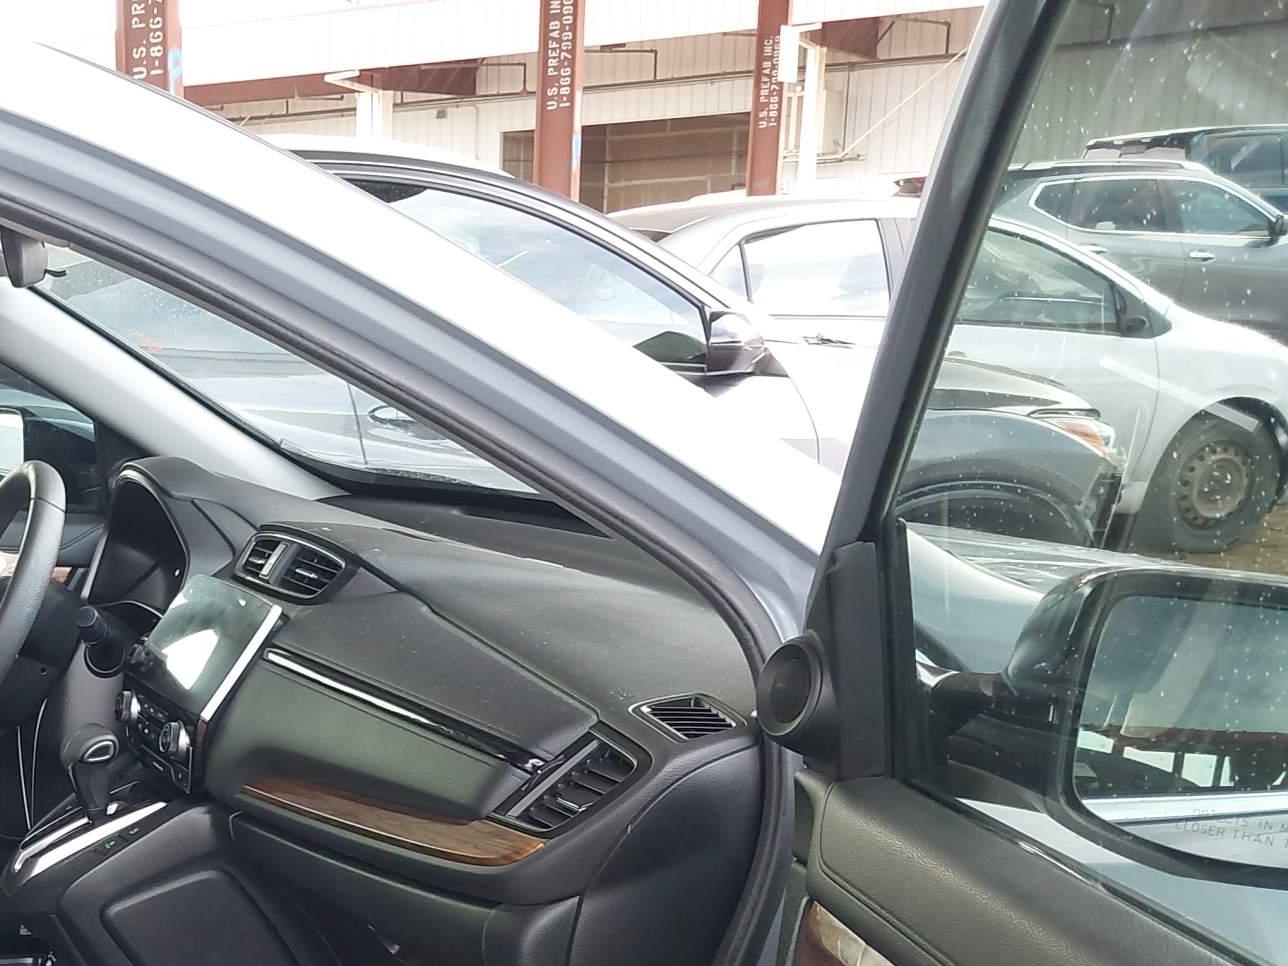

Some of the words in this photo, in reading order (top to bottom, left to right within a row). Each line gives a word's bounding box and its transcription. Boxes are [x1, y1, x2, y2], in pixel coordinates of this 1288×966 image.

[132, 40, 147, 80] U.S.
[548, 20, 560, 76] PREFAB
[763, 35, 774, 57] INC.
[760, 61, 772, 103] PREFAB
[546, 83, 559, 110] U.S.
[758, 107, 769, 129] U.S.
[1175, 818, 1226, 837] CLOSER
[1232, 829, 1274, 846] THAN
